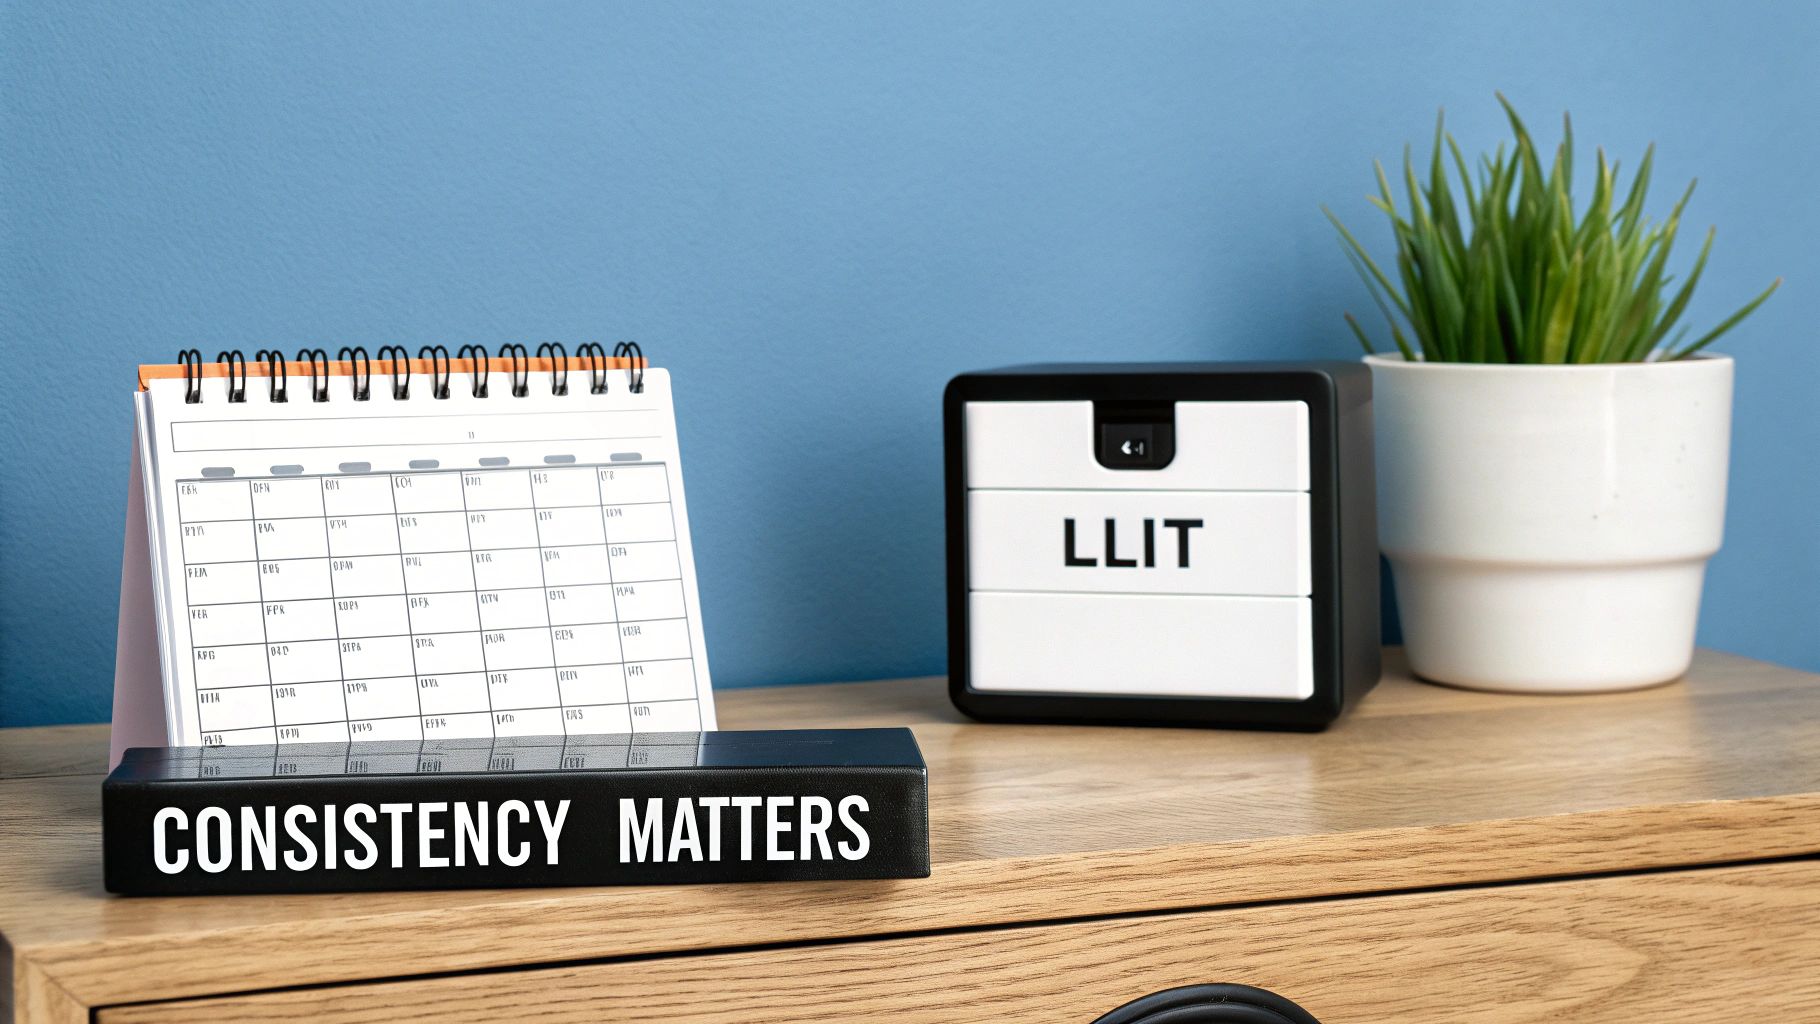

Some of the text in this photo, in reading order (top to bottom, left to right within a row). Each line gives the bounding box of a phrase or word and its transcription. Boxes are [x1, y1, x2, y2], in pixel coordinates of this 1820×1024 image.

[1064, 518, 1204, 568] LLIT
[153, 794, 870, 875] CONSISTENCY MATTERS
